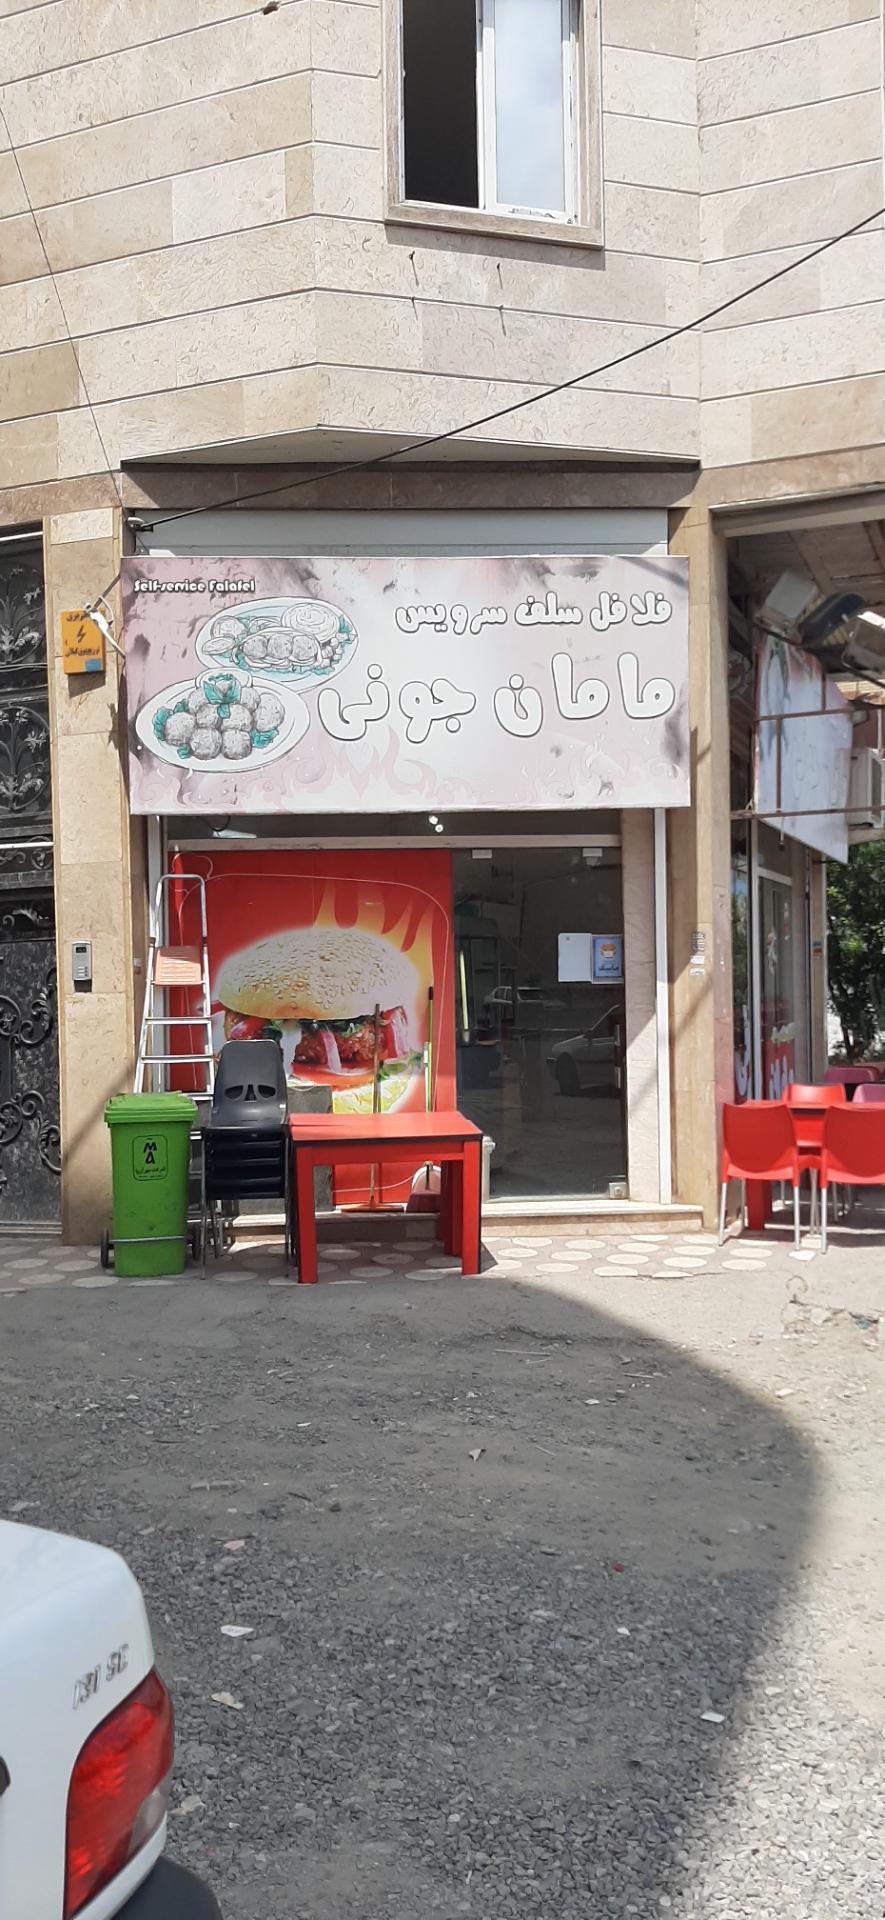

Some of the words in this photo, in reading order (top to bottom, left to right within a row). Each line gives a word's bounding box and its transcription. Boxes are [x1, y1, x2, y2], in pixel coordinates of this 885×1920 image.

[133, 579, 206, 593] Self-service
[208, 579, 256, 593] Falafel
[514, 591, 584, 626] سلف
[395, 603, 508, 635] سرویس
[317, 663, 477, 744] جونی
[493, 652, 676, 738] مامان
[72, 1664, 101, 1710] 131
[106, 1643, 129, 1682] SE
